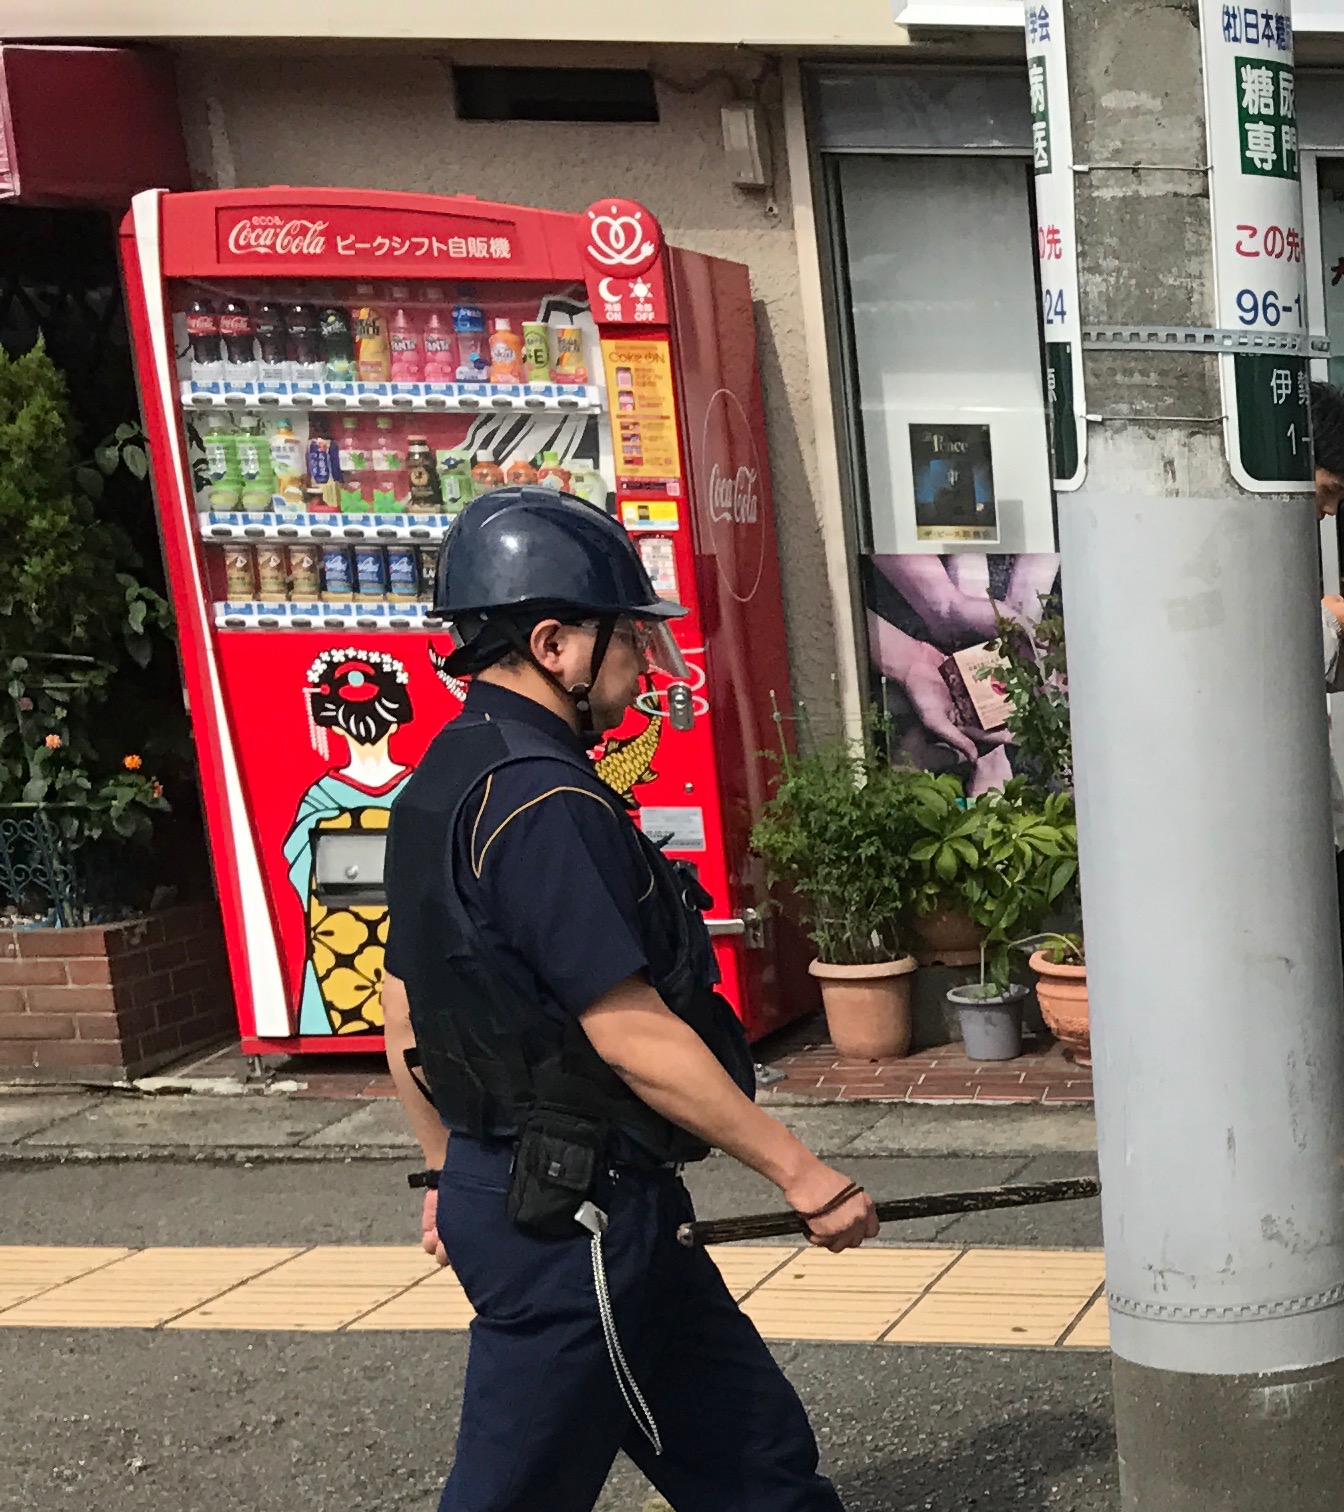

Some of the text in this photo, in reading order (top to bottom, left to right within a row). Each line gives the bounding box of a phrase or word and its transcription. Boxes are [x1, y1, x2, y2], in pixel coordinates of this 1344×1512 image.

[336, 234, 512, 259] ピークシフト自販機
[605, 312, 655, 322] ON OFF
